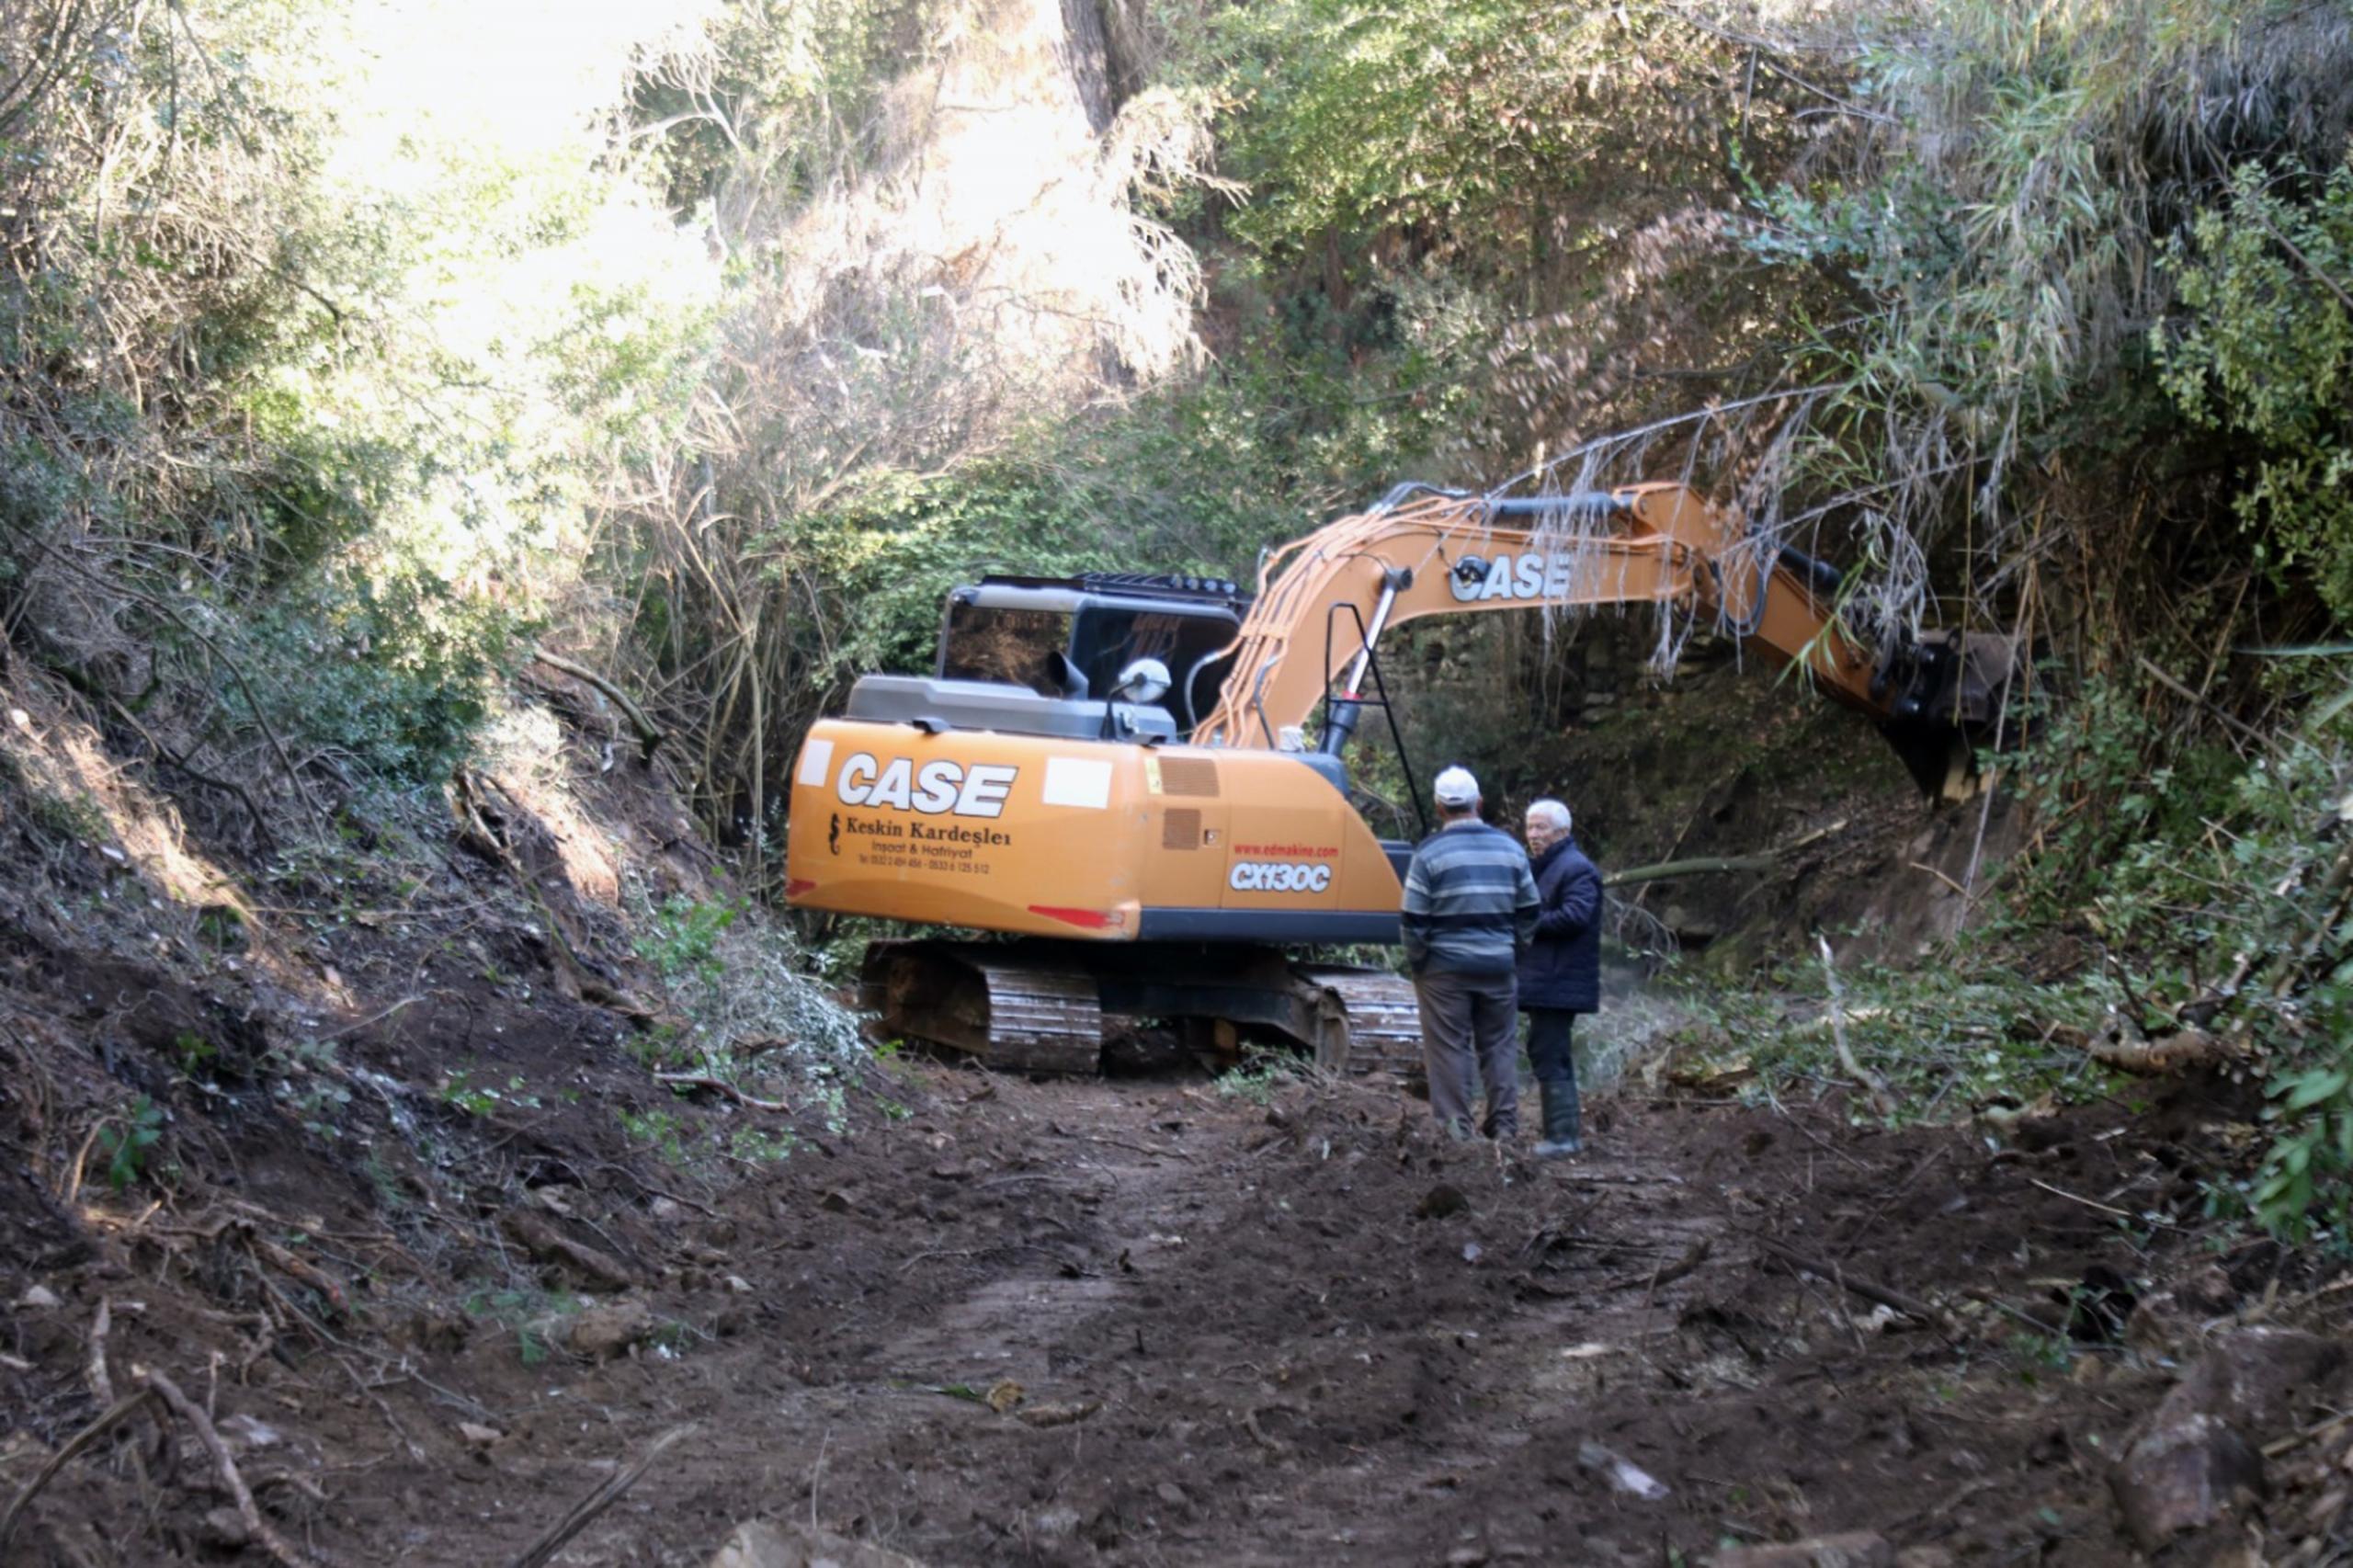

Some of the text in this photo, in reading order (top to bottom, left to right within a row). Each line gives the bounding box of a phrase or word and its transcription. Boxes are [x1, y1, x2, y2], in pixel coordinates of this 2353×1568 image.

[1451, 553, 1574, 603] CASE
[837, 752, 1019, 818] CASE
[847, 817, 903, 837] Keskin
[910, 844, 917, 854] &
[922, 845, 973, 860] Hafriyat
[1234, 843, 1338, 858] www.edmakine.com
[1230, 861, 1332, 892] CX130C
